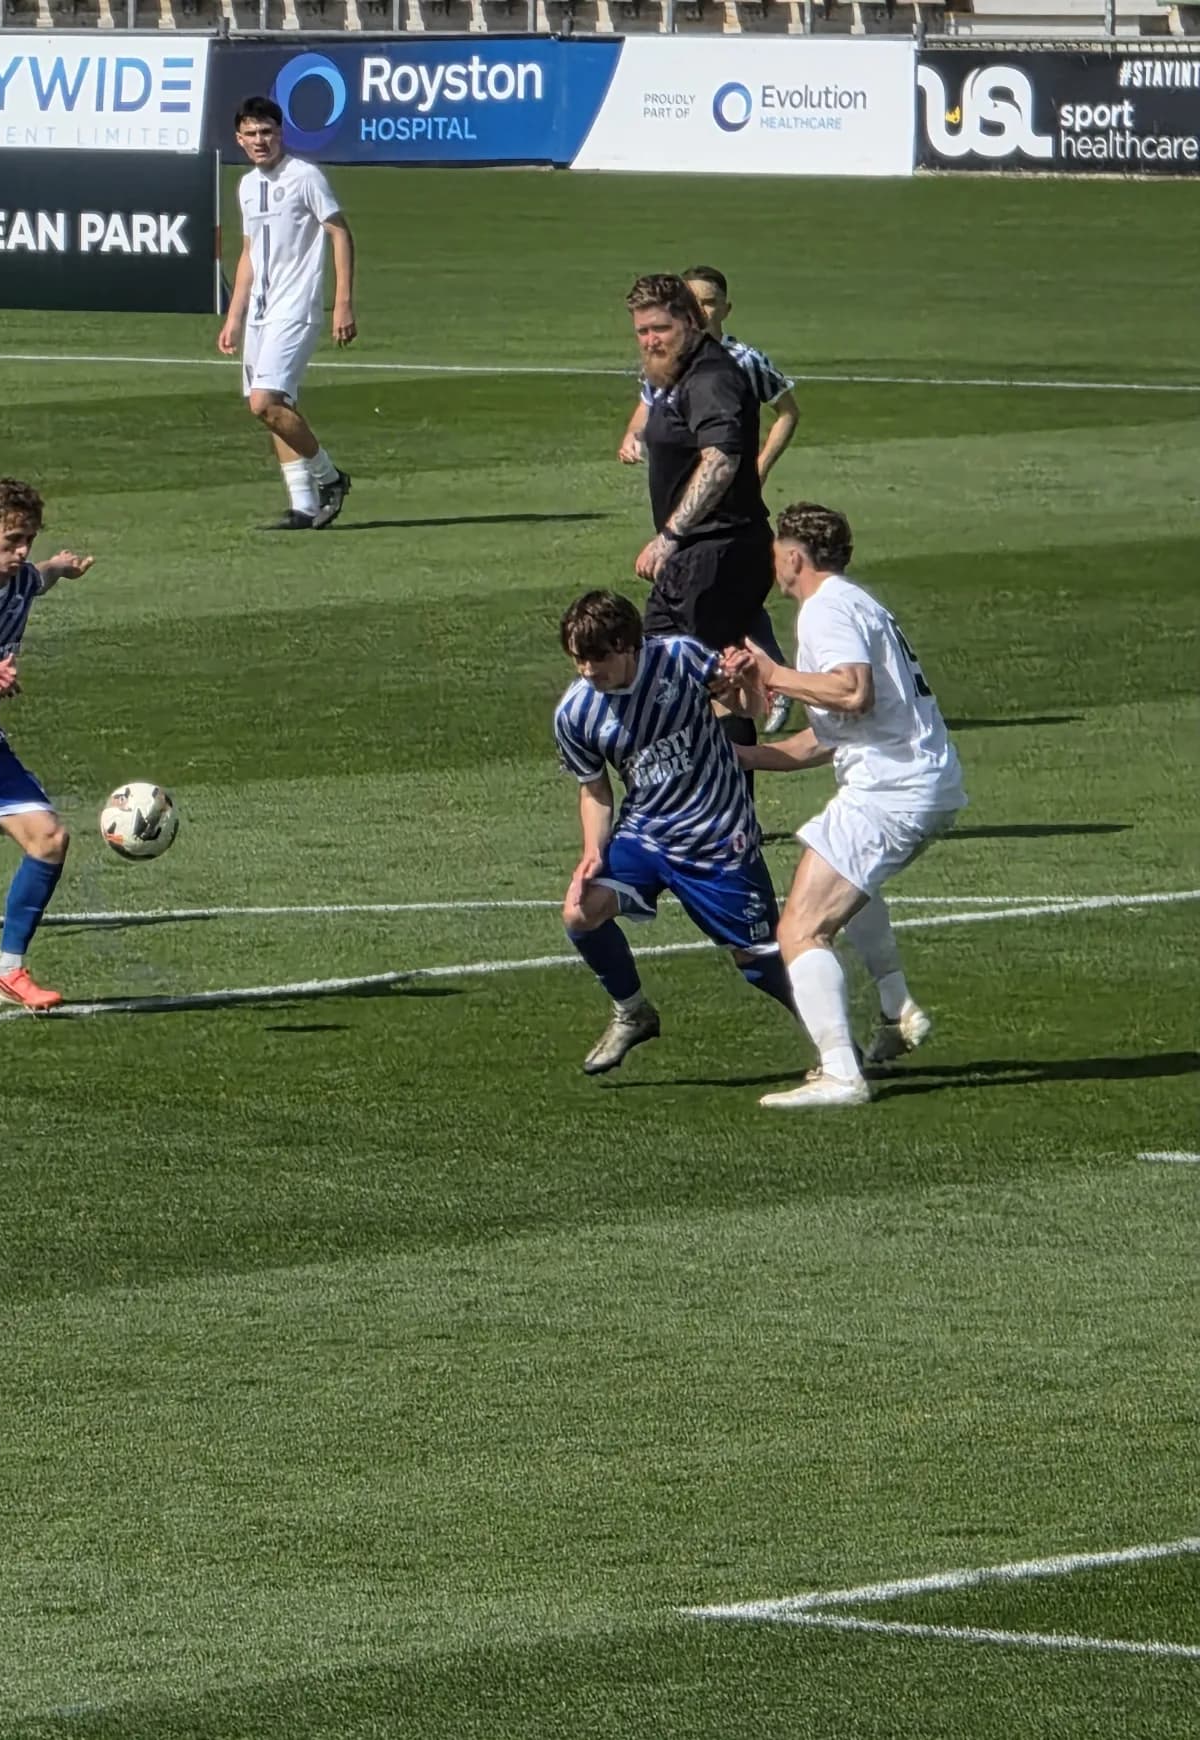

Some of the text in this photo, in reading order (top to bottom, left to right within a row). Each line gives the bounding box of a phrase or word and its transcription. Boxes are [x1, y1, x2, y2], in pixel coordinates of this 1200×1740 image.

[361, 56, 543, 112] Royston
[644, 93, 695, 104] PROUDLY
[761, 84, 867, 109] Evolution
[643, 107, 690, 118] PART OF
[760, 117, 842, 129] HEALTHCARE
[1060, 100, 1136, 130] sport
[77, 128, 190, 146] LIMITED
[361, 117, 477, 140] HOSPITAL
[1061, 132, 1199, 159] healthcare
[80, 213, 189, 253] PARK
